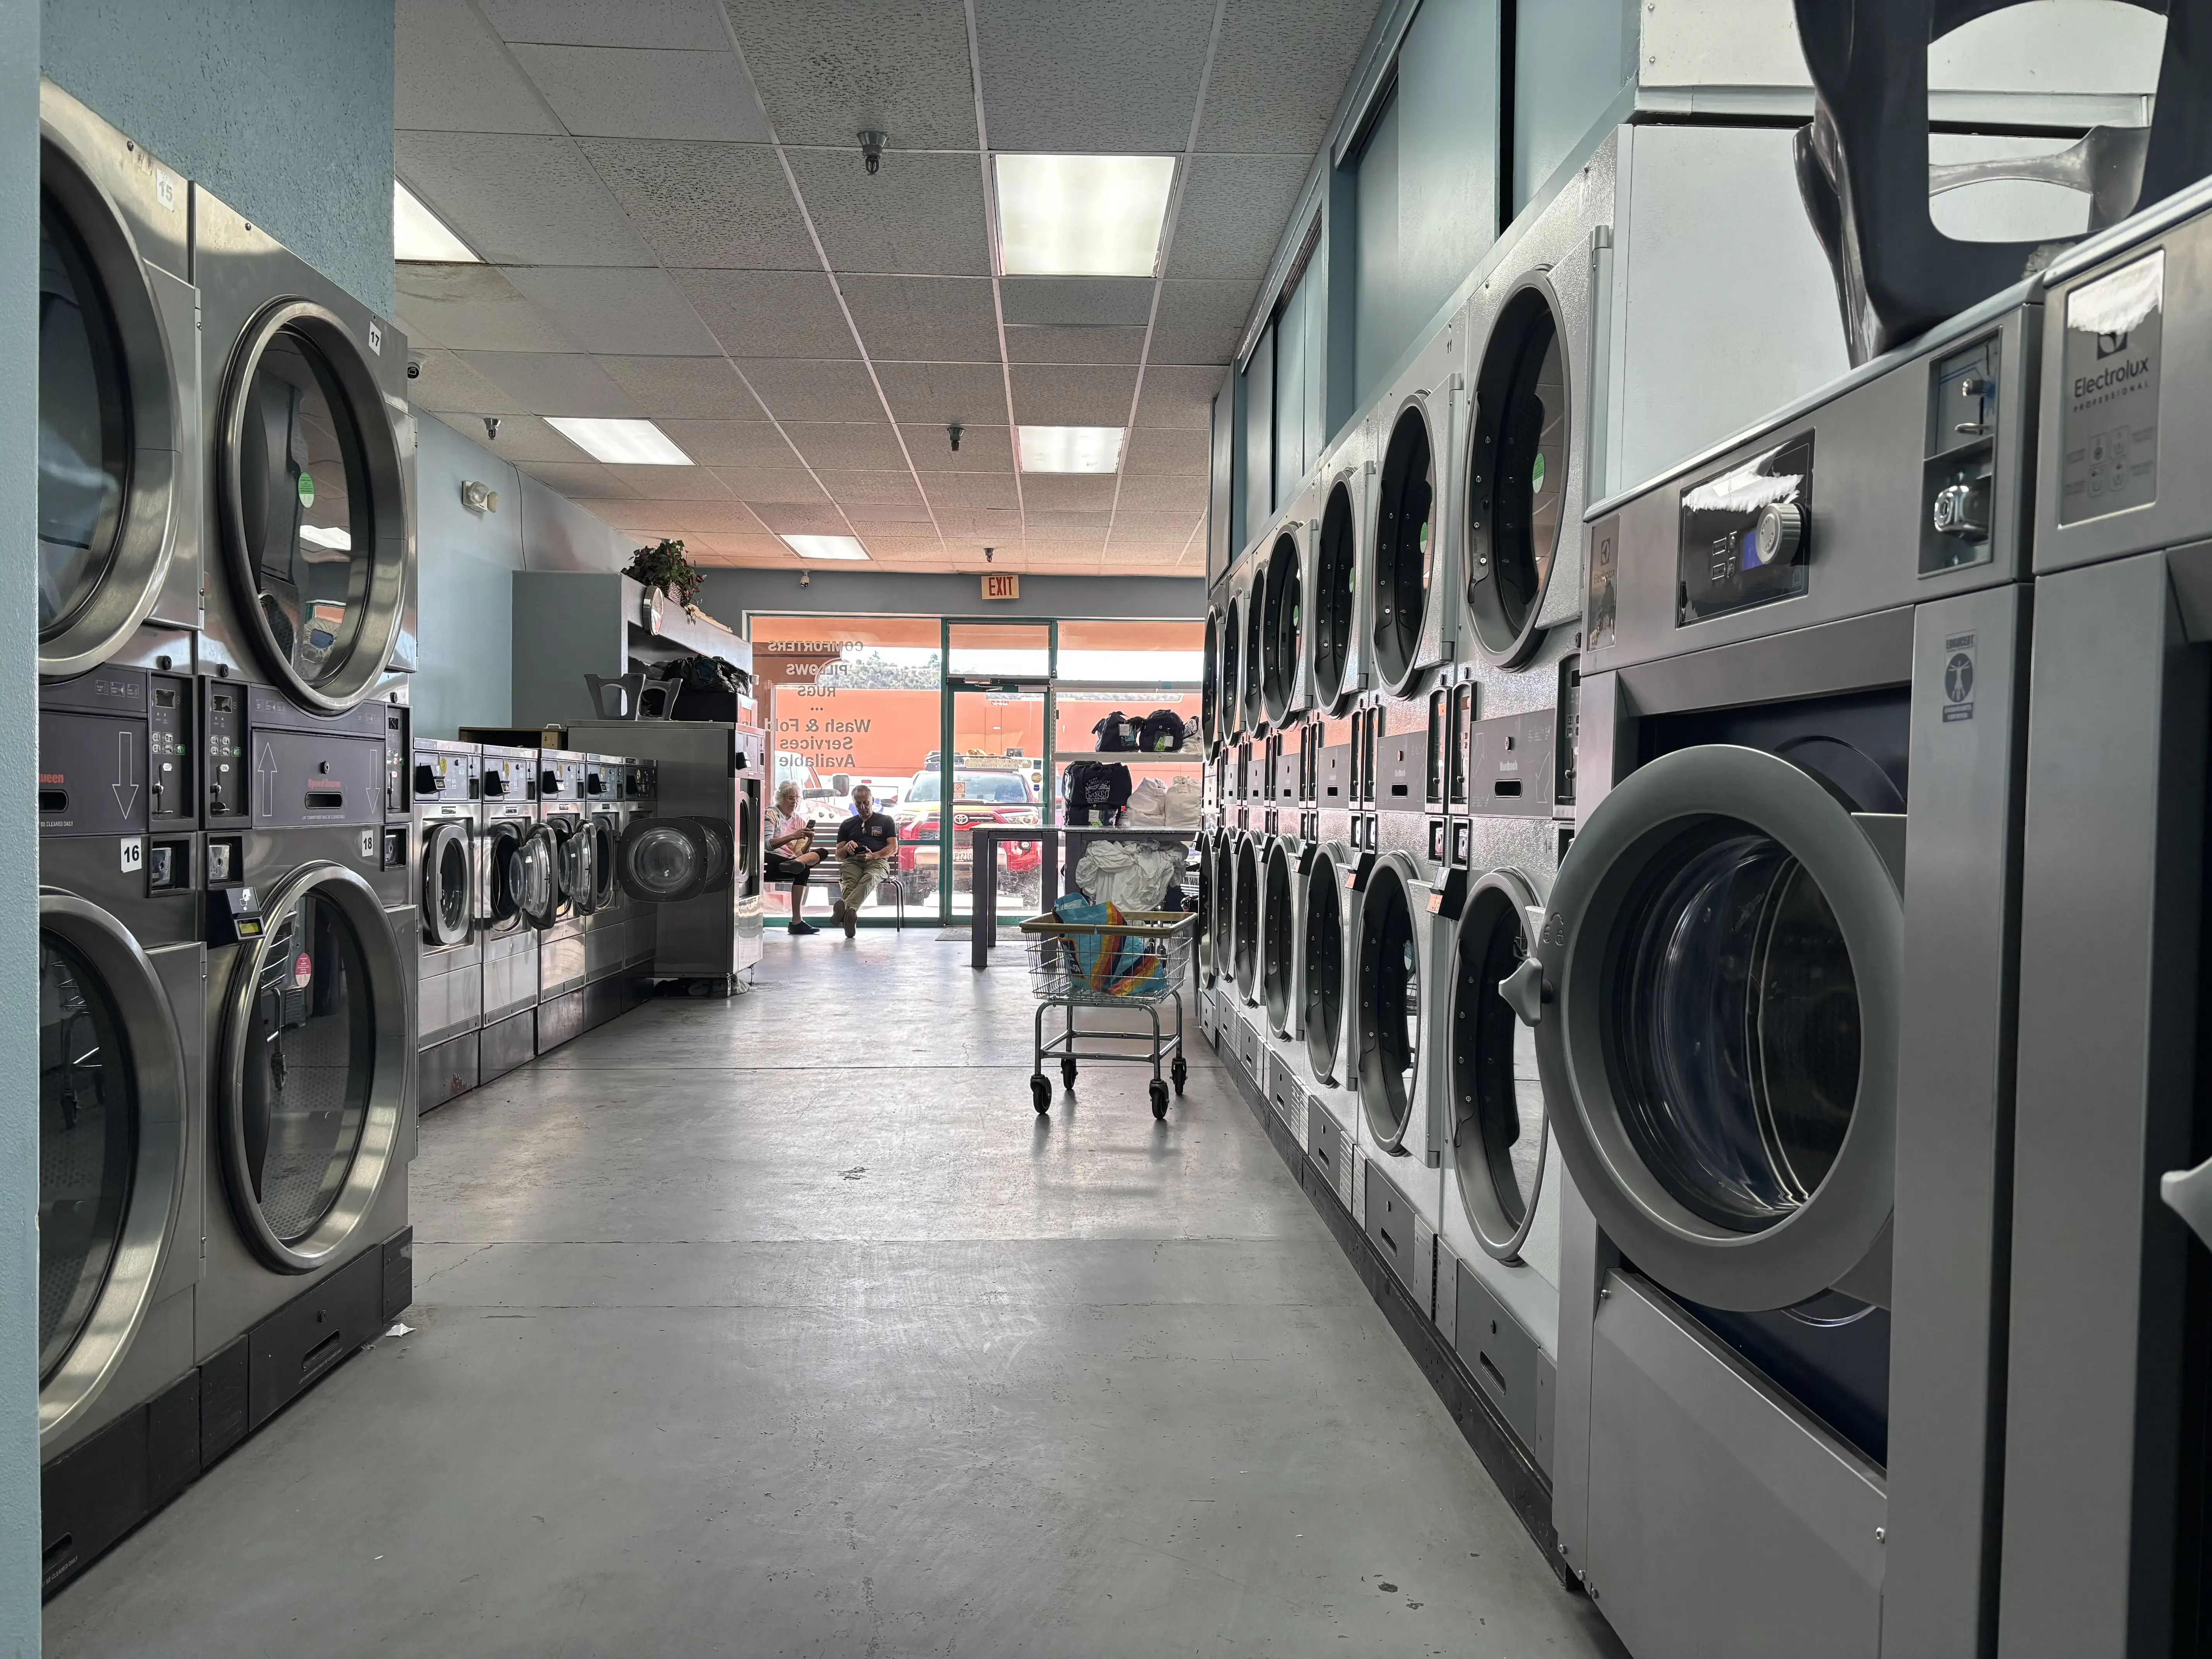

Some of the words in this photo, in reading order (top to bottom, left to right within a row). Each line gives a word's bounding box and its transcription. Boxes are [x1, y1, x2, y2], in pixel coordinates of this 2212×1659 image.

[159, 181, 172, 202] 15
[371, 331, 379, 347] 17
[2075, 357, 2148, 397] Electrolux
[2073, 380, 2148, 412] PROFESSIONAL
[989, 577, 1013, 596] EXIT
[39, 773, 64, 783] ueen
[364, 837, 372, 850] 18
[124, 845, 139, 863] 16
